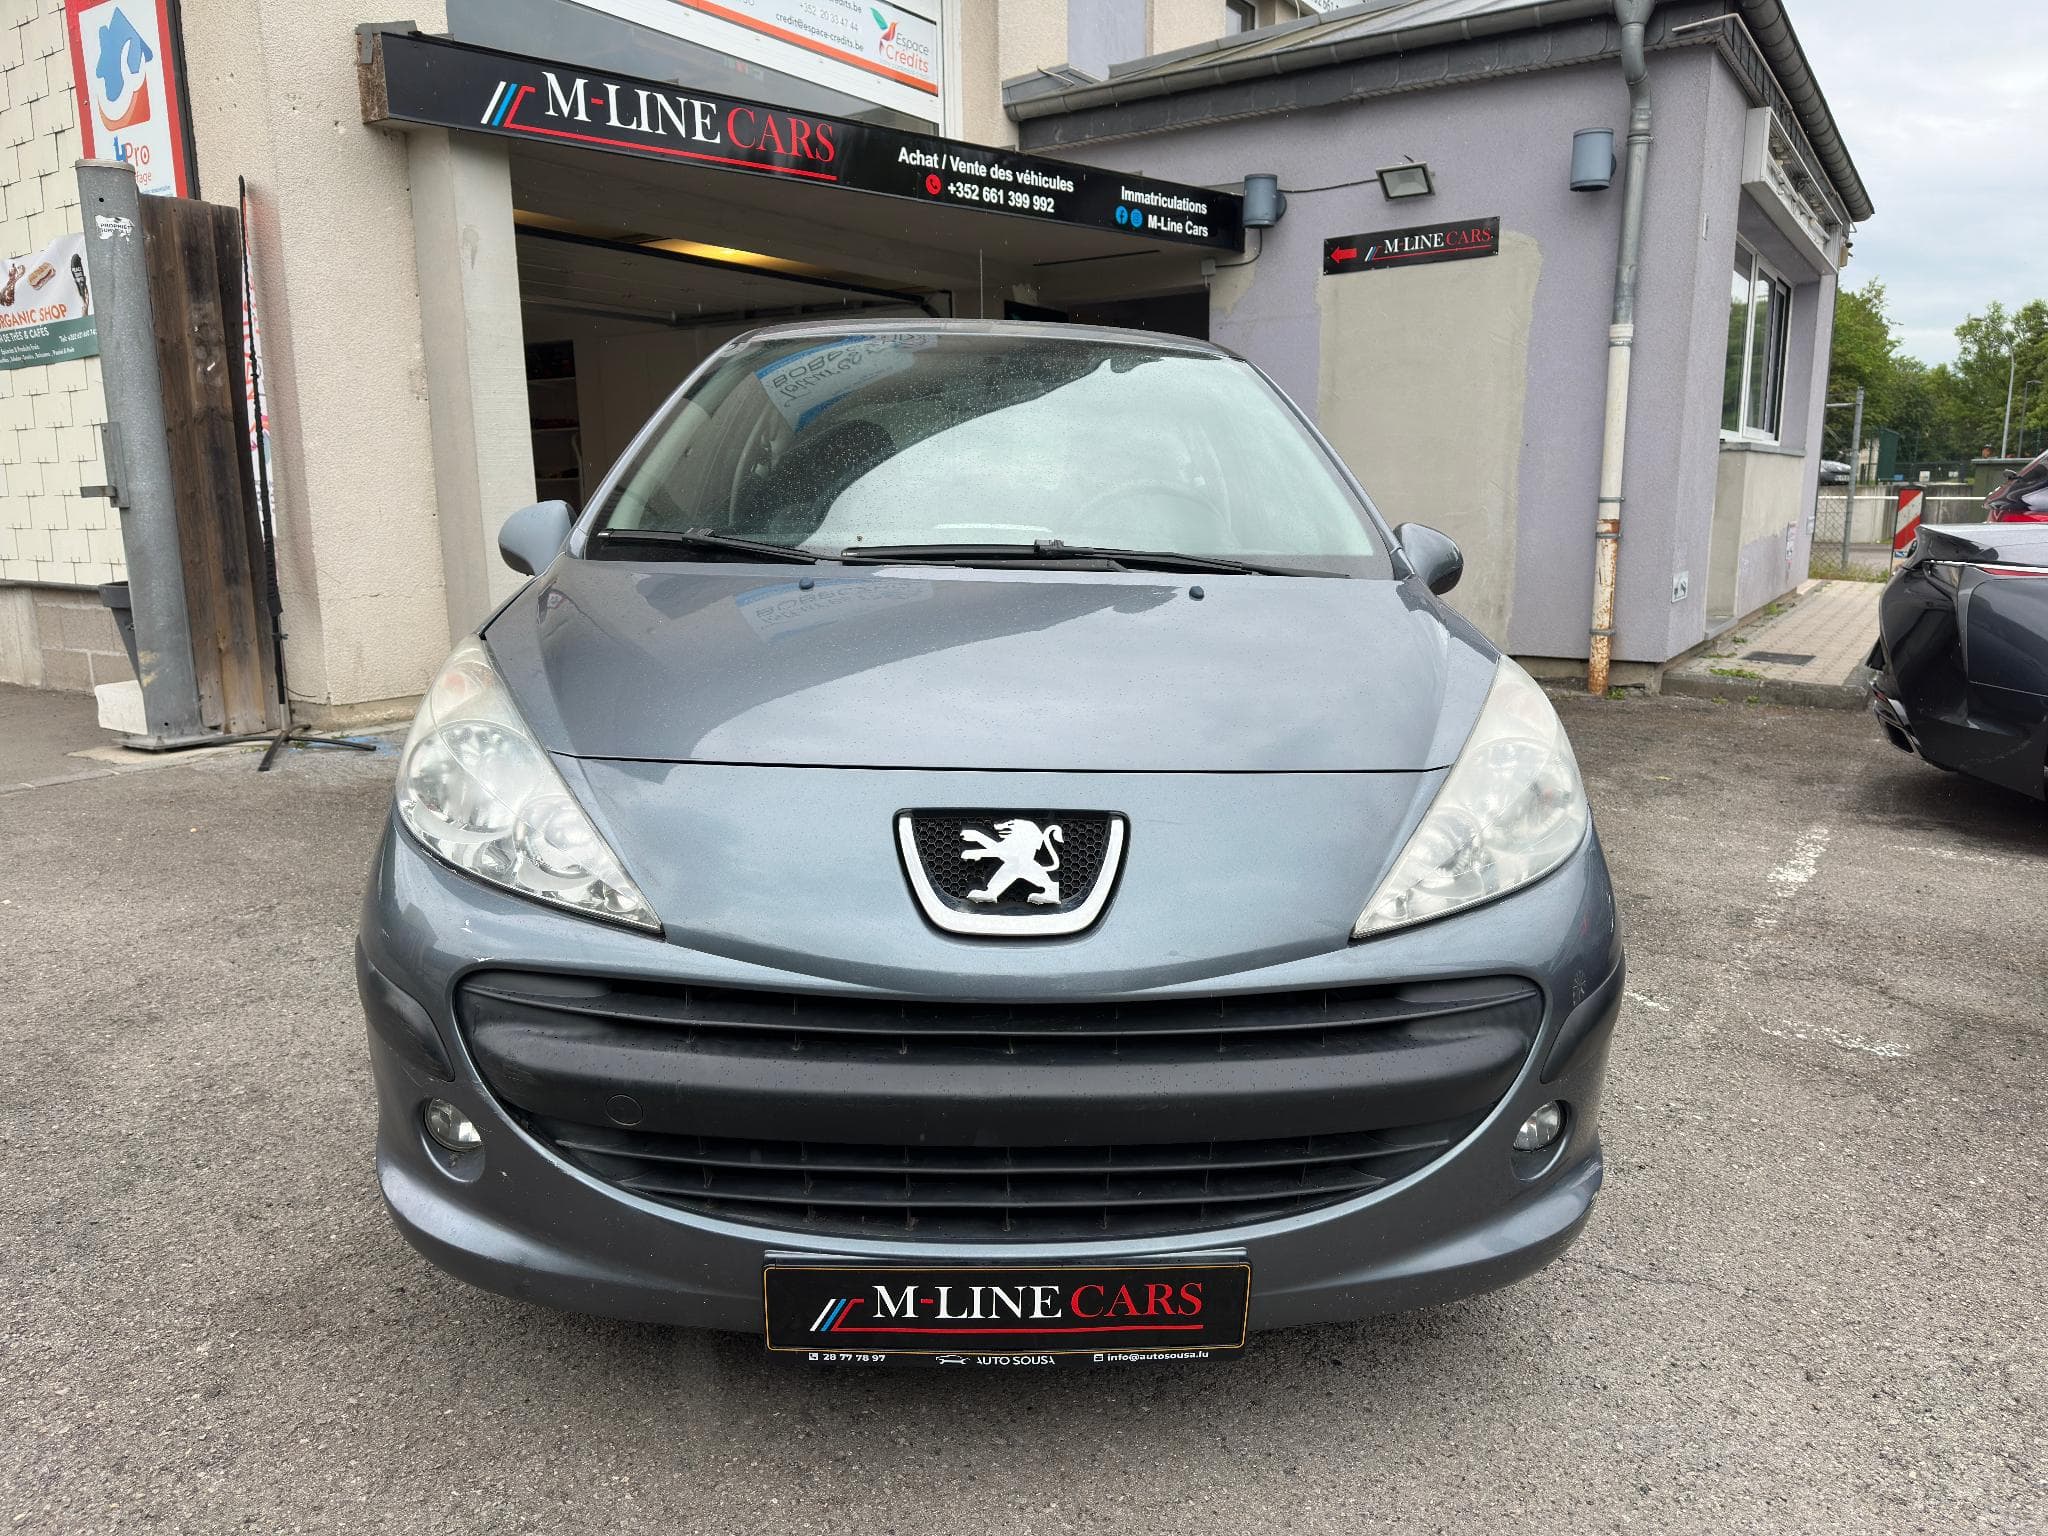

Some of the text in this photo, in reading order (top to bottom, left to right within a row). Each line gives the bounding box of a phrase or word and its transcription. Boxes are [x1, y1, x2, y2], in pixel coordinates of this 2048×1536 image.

[776, 13, 864, 52] credit@espace-credits.be
[896, 32, 929, 55] Espace
[886, 44, 929, 73] Crédits
[542, 71, 835, 162] M-LINE CARS
[898, 147, 1075, 193] Achat / Vente des véhicules
[948, 181, 1055, 213] +352 661 399 992
[1121, 186, 1208, 215] Immatriculations
[1148, 214, 1209, 237] M-Line Cars
[1384, 227, 1491, 254] M-LINE CARS
[0, 303, 67, 329] RGANIC SHOP
[872, 1282, 1203, 1320] M-LINE CARS
[823, 1353, 886, 1362] 28 77 78 97
[976, 1355, 1056, 1365] AUTO SOUSA
[1107, 1351, 1209, 1362] info@autosousa.lu
